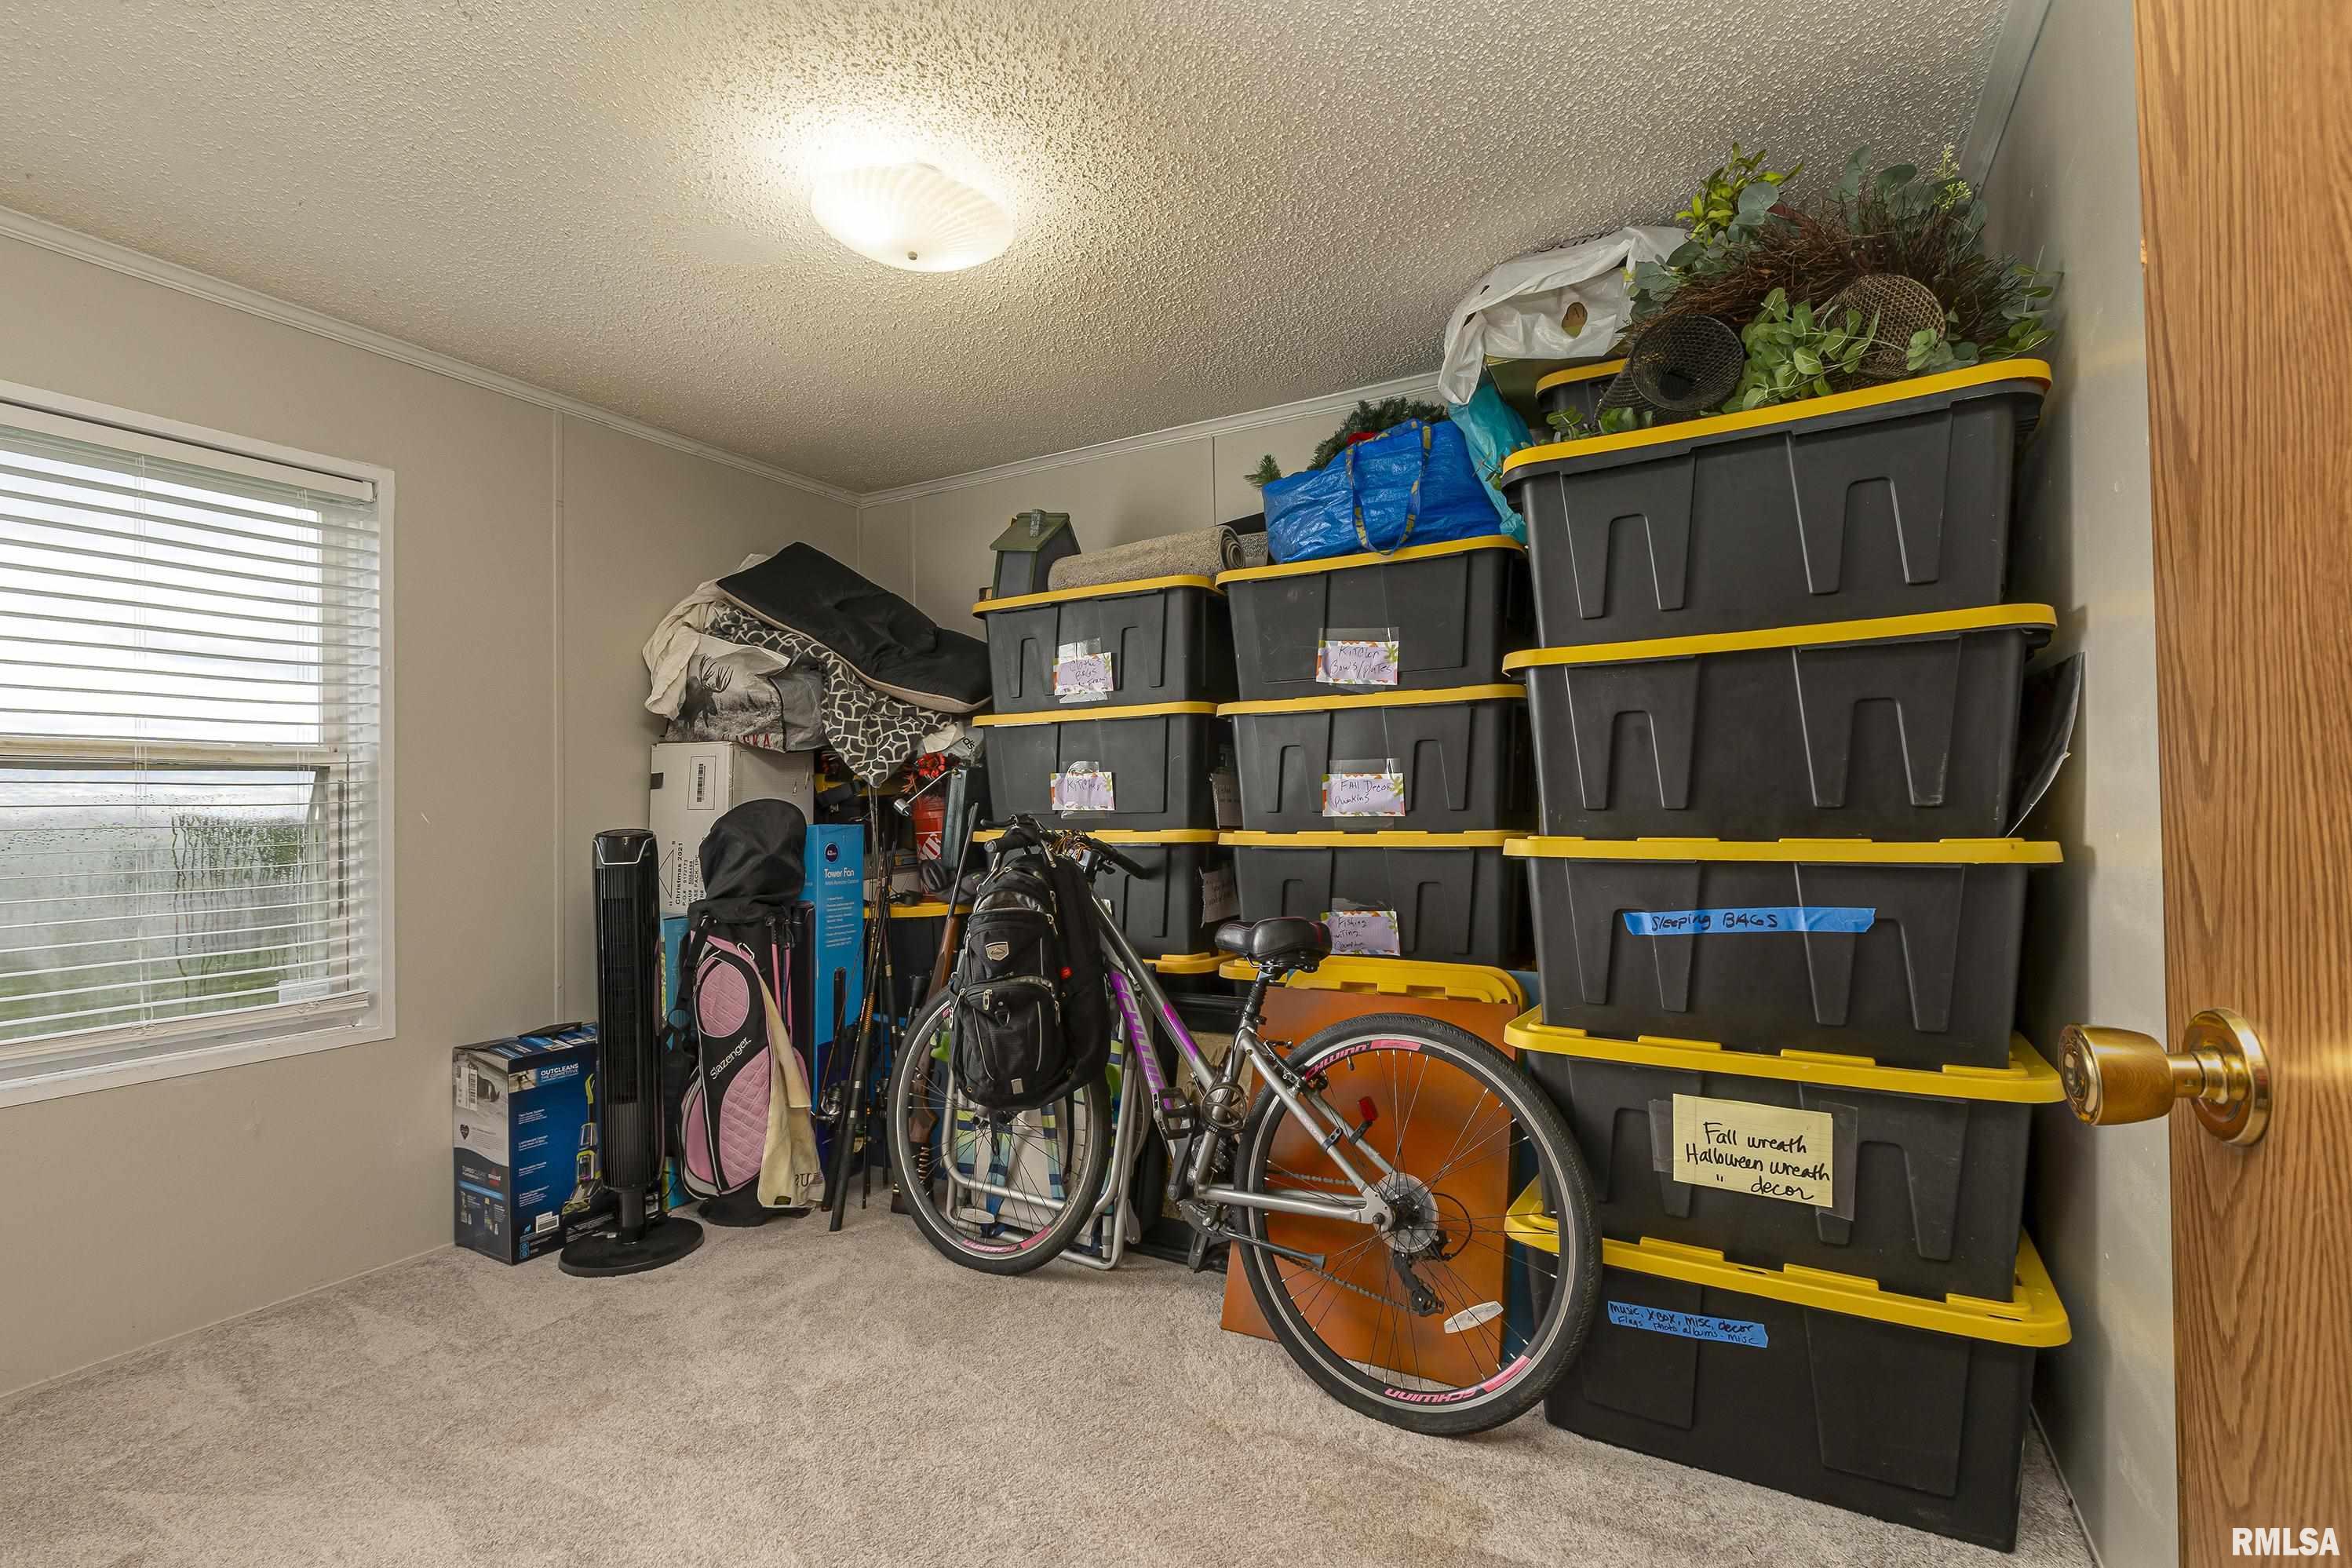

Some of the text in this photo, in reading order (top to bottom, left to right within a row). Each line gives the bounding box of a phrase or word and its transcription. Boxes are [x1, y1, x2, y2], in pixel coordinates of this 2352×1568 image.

[824, 867, 855, 878] Tower Fan
[1651, 913, 1711, 932] Sleeping
[540, 1063, 579, 1076] OUTCLEANS
[709, 1037, 753, 1080] Slazenger
[1702, 1121, 1807, 1154] Fall wreath
[1686, 1143, 1830, 1181] Halloween wreath
[1750, 1175, 1814, 1201] decor
